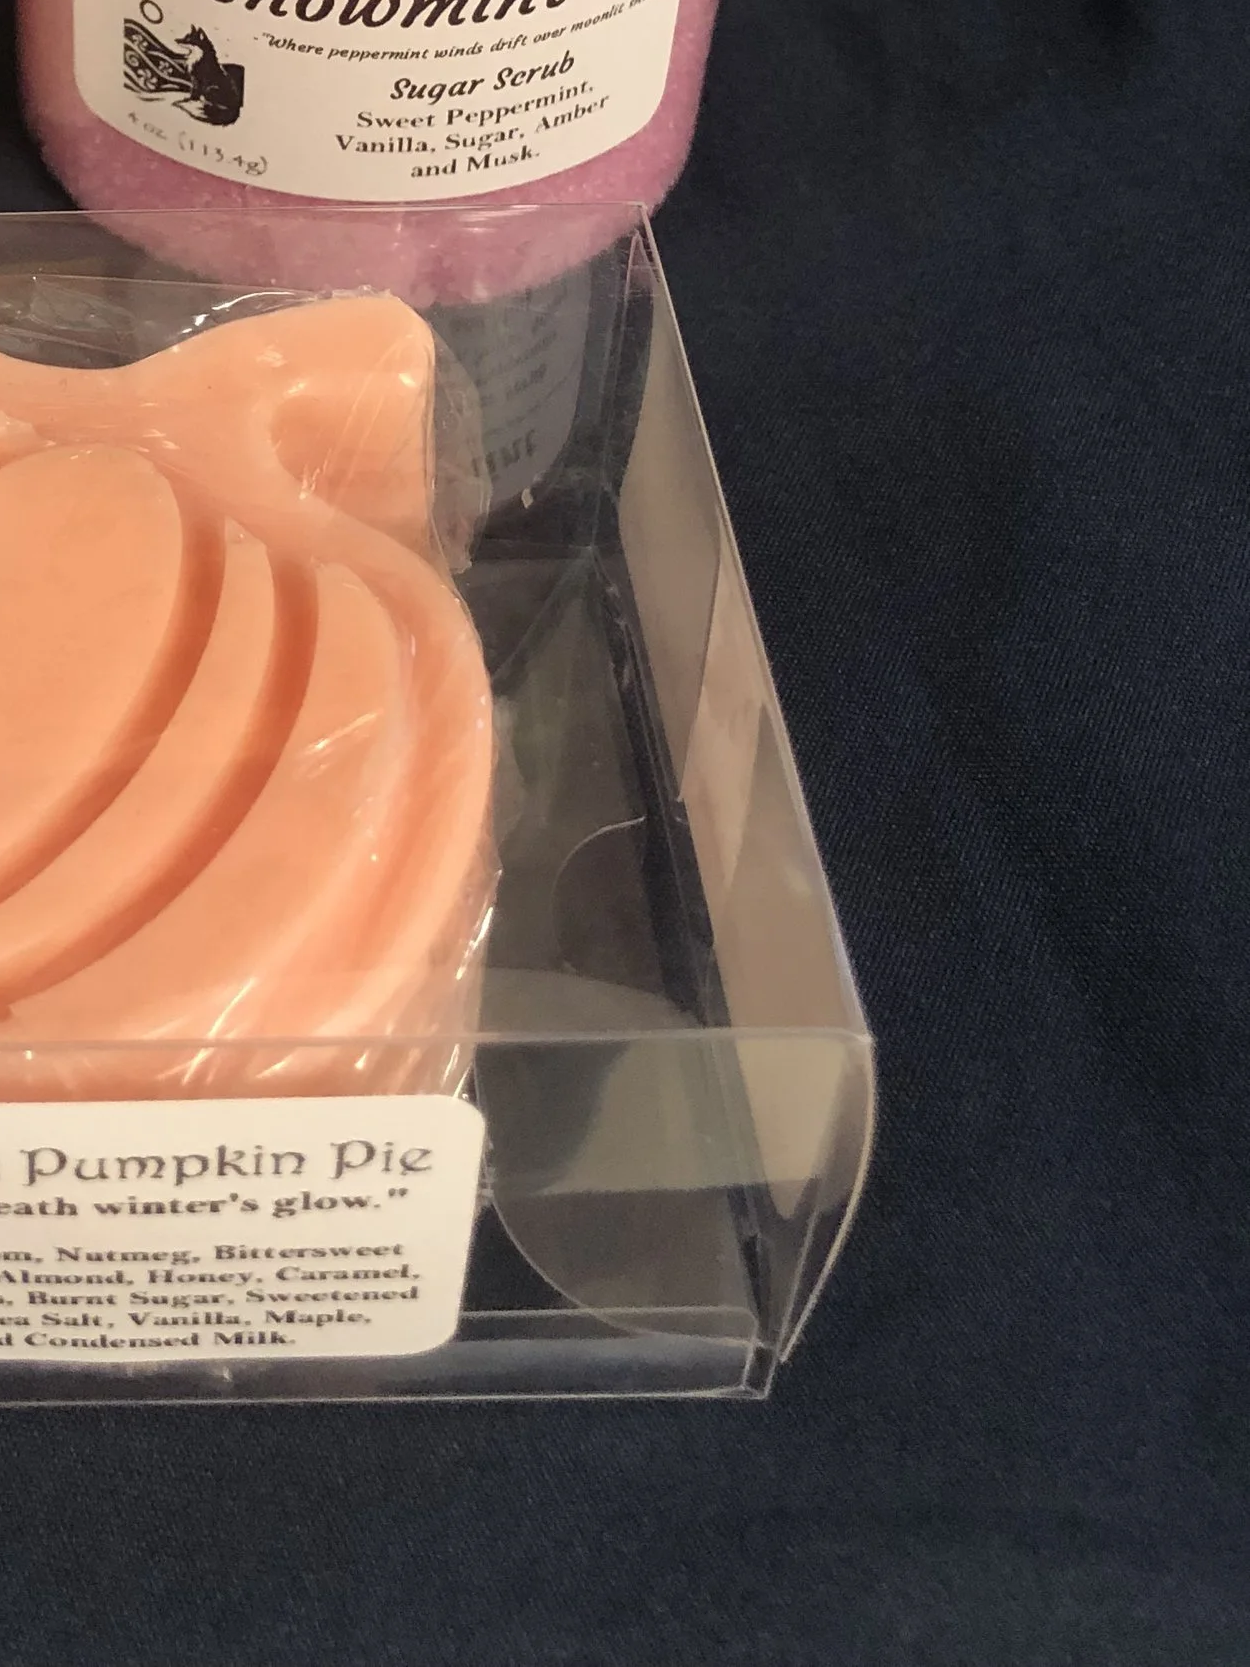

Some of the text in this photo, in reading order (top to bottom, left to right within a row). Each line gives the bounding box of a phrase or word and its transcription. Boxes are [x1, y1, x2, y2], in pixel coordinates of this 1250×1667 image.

[253, 32, 324, 55] -"Where
[327, 45, 429, 62] peppermint
[434, 41, 483, 59] winds
[490, 34, 528, 53] drift
[534, 26, 566, 44] over
[571, 4, 625, 33] moonlit
[390, 50, 574, 105] Sugar Scrub
[356, 79, 593, 128] Sweet Peppermint,
[336, 134, 436, 153] Vanilla,
[445, 126, 525, 151] Sugar,
[411, 145, 540, 177] and Musk.
[20, 1145, 306, 1186] Pumpkin
[330, 1139, 433, 1179] Pie
[93, 1192, 259, 1216] winter's
[273, 1187, 408, 1218] glow."
[54, 1246, 201, 1265] Nutmeg,
[214, 1243, 403, 1260] Bittersweet
[148, 1269, 263, 1285] Honey,
[276, 1263, 421, 1281] Caramel,
[27, 1290, 117, 1305] Burnt
[129, 1291, 234, 1308] Sugar,
[246, 1286, 419, 1302] Sweetened
[41, 1312, 114, 1329] Salt,
[129, 1311, 251, 1326] Vanilla,
[265, 1309, 372, 1327] Maple,
[24, 1332, 199, 1348] Condensed
[214, 1332, 296, 1346] Milk.
